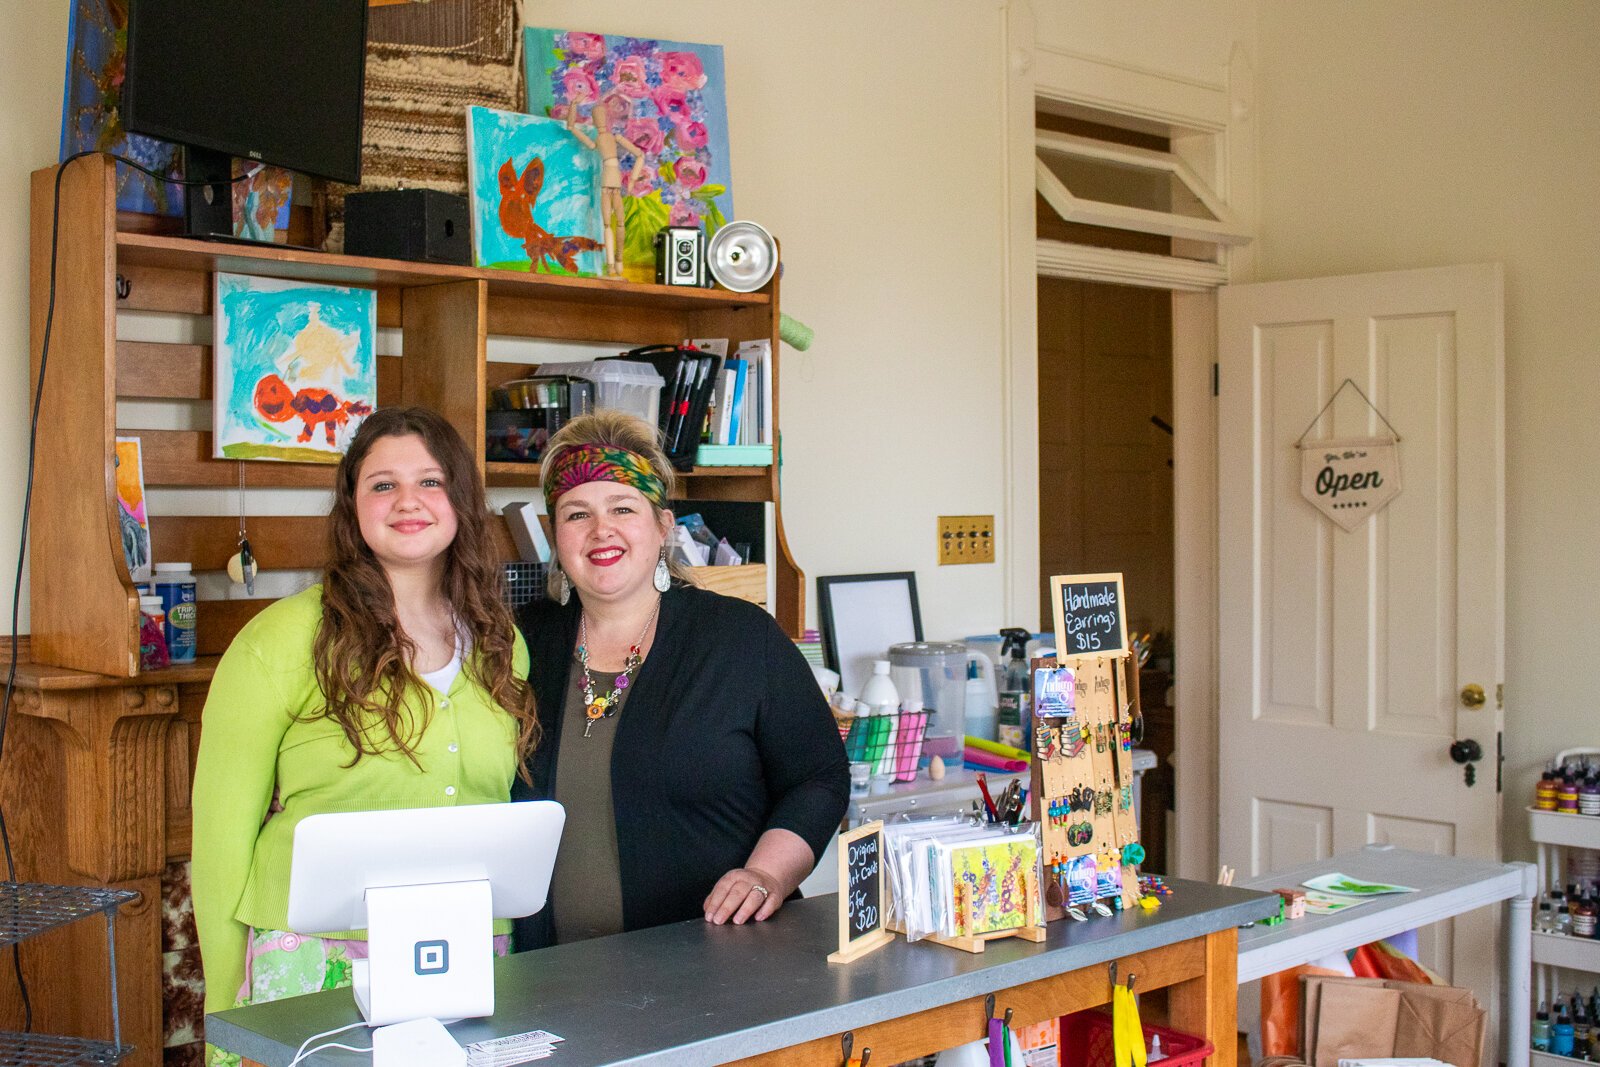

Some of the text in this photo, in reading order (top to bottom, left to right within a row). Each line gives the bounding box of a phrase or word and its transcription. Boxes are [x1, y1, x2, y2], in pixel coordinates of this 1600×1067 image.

[1315, 466, 1384, 498] Open
[1064, 586, 1116, 612] Handmade
[1065, 611, 1116, 634] Earrings
[1076, 632, 1101, 650] $15
[848, 839, 878, 866] Original
[855, 889, 867, 909] for
[855, 905, 878, 931] $20
